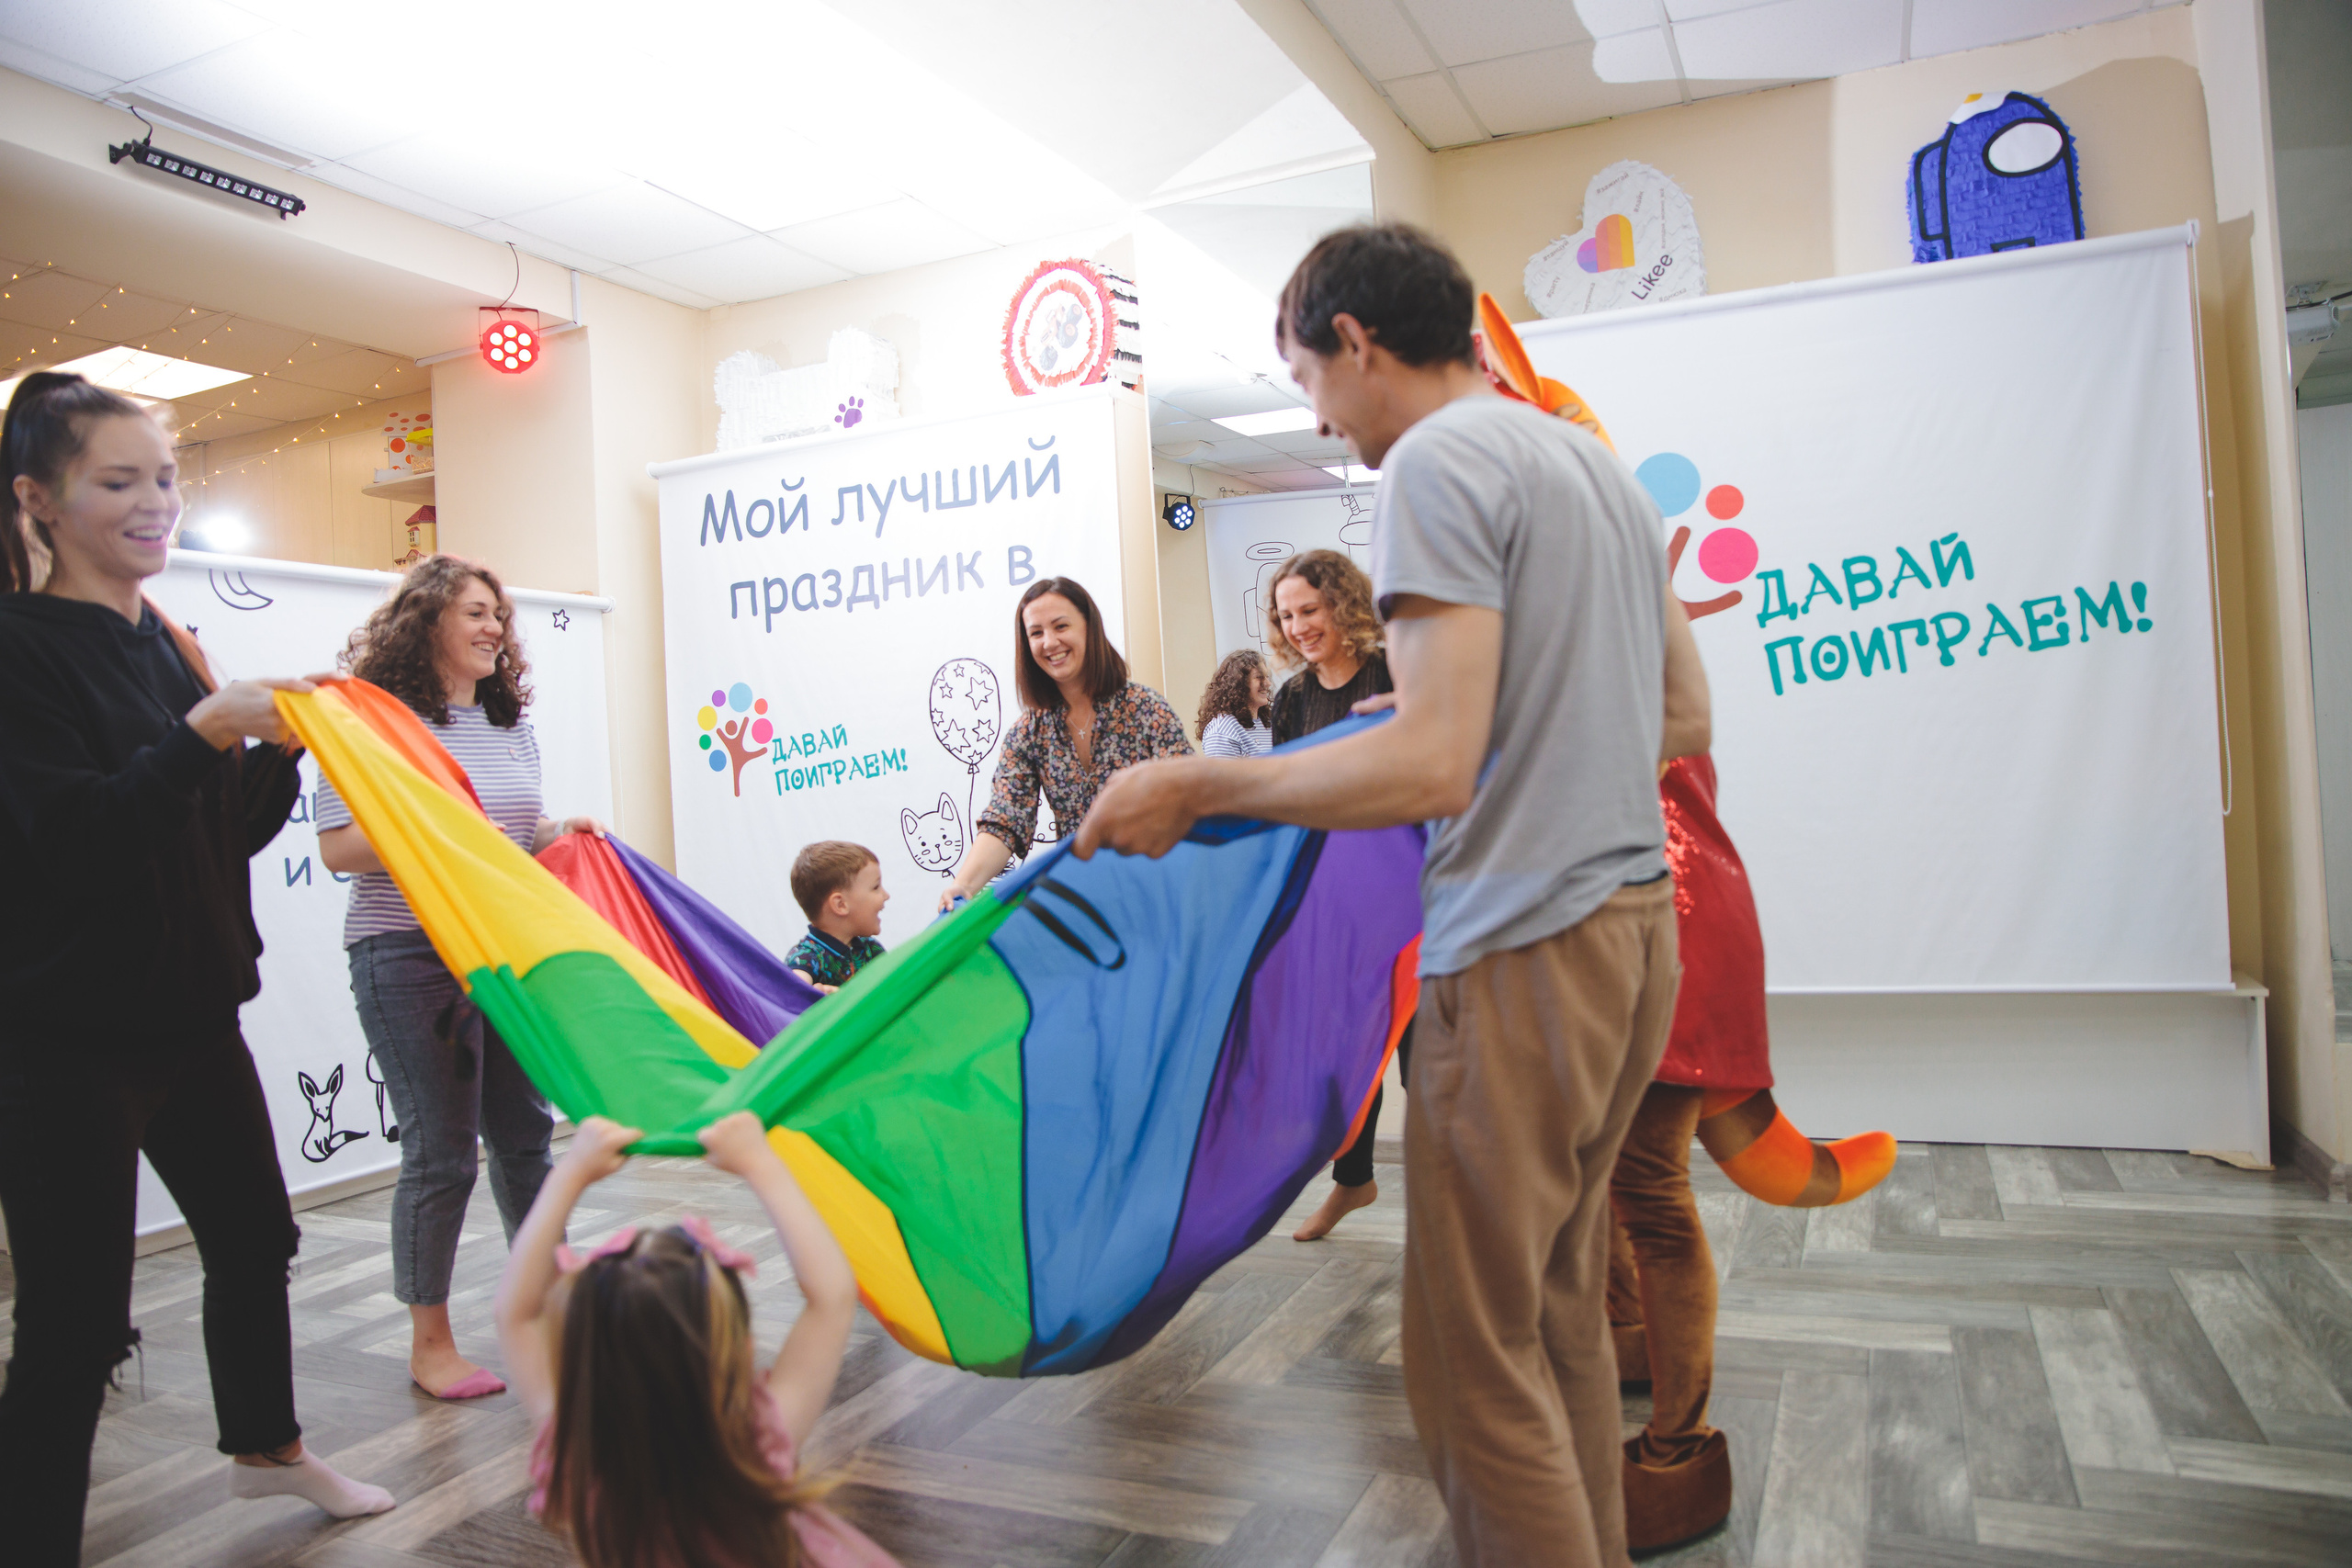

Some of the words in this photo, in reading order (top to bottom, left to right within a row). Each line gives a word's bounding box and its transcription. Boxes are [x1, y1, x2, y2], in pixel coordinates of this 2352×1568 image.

[1631, 254, 1673, 300] Likee
[700, 477, 808, 547] Мой
[831, 434, 1061, 539] лучший
[730, 550, 984, 634] праздник
[1008, 545, 1036, 586] в
[1756, 532, 1974, 628] ДАВАЙ
[1764, 581, 2153, 696] ПОИГРАЕМ!
[772, 724, 848, 765] ДАВАЙ
[775, 748, 908, 796] ПОИГРАЕМ!
